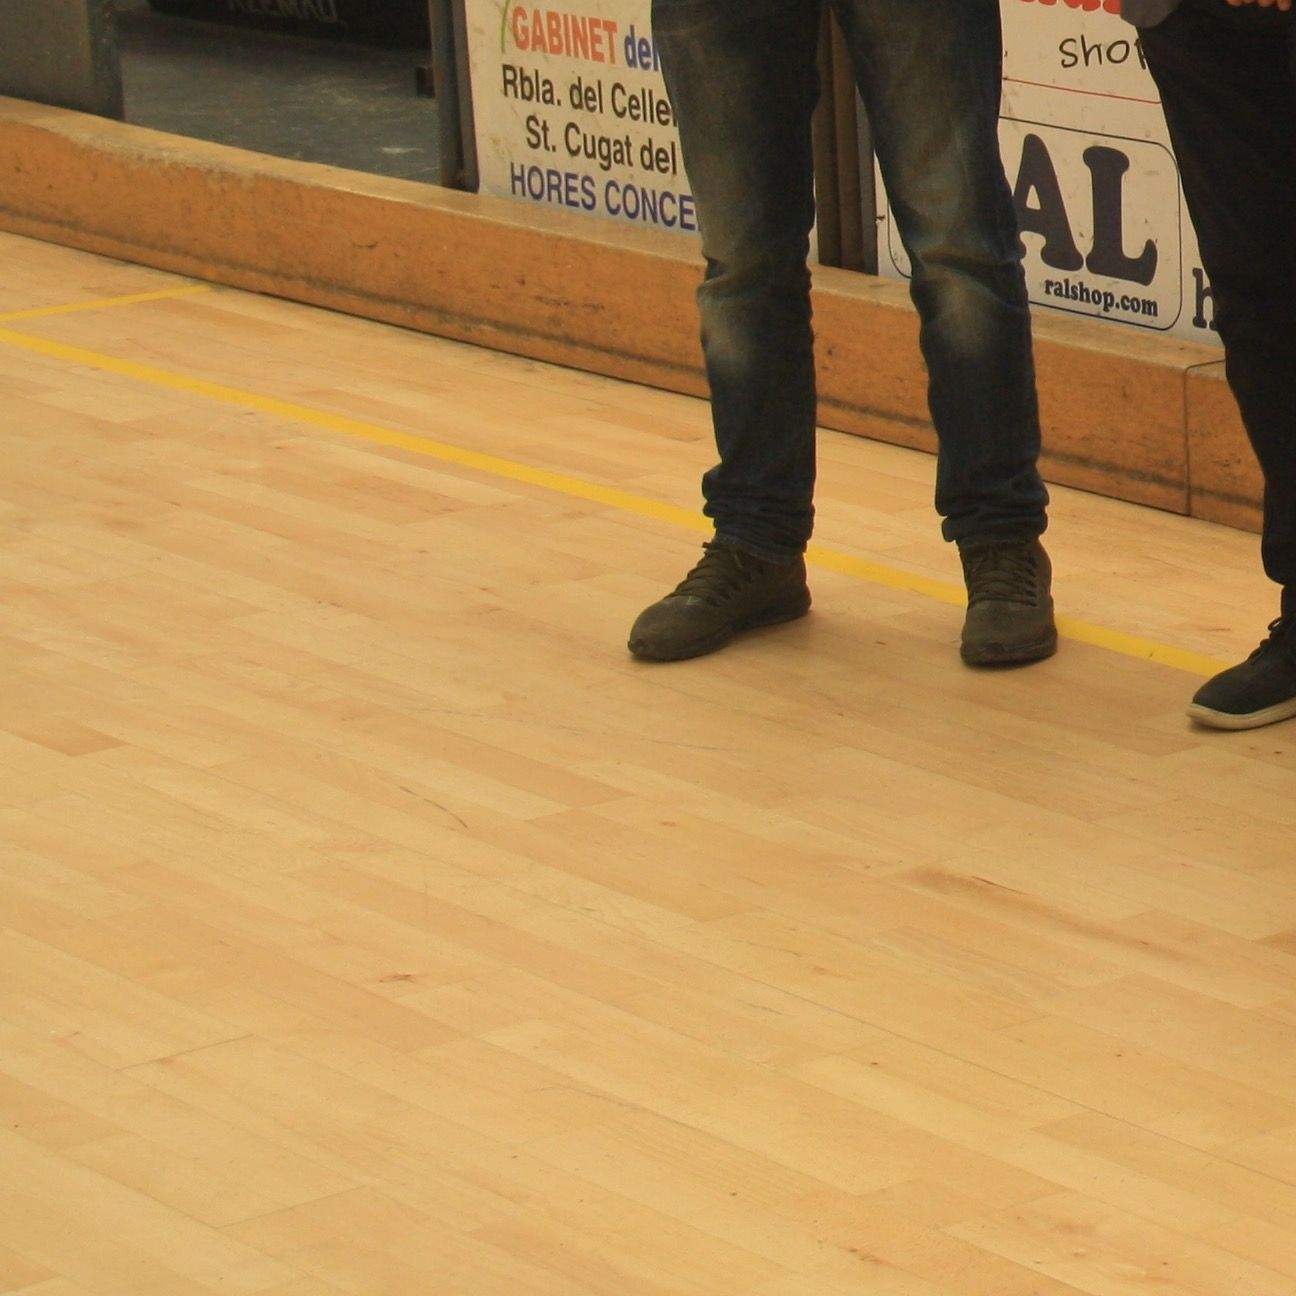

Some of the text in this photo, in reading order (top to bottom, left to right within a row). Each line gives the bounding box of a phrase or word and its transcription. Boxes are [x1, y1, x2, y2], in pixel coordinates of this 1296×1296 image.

[512, 6, 618, 65] GABINET
[502, 64, 561, 106] Rbla.
[569, 76, 604, 114] del
[526, 115, 678, 175] St. Cugat del
[511, 162, 701, 232] HORES CONCE
[1043, 278, 1159, 317] ralshop.com
